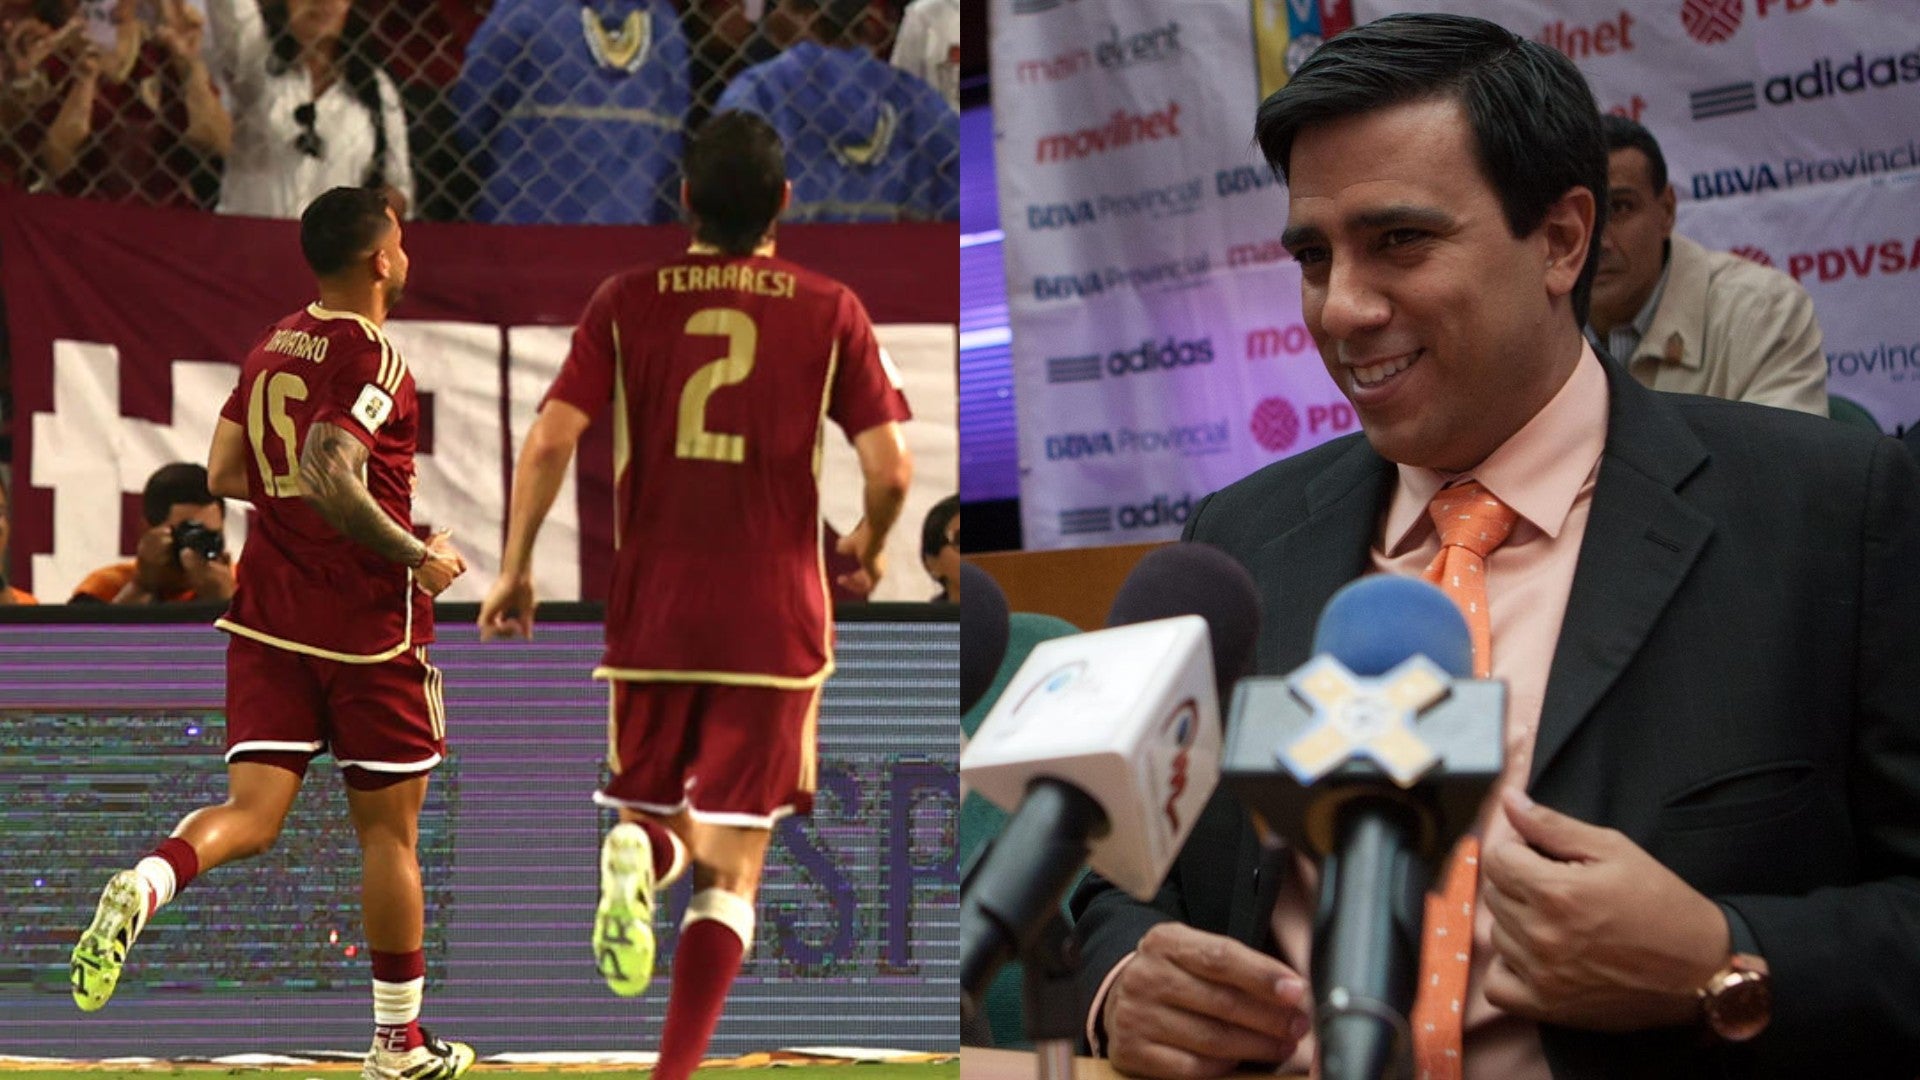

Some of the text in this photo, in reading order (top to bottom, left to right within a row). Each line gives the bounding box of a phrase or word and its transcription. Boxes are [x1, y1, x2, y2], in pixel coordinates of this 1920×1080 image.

[1764, 52, 1920, 105] adidas
[1692, 163, 1778, 202] BBVA
[657, 263, 796, 300] FERRARESI
[1107, 336, 1215, 377] adidas
[674, 307, 758, 464] 2
[247, 368, 309, 498] 15
[1307, 402, 1355, 435] PD
[1118, 493, 1192, 530] adid
